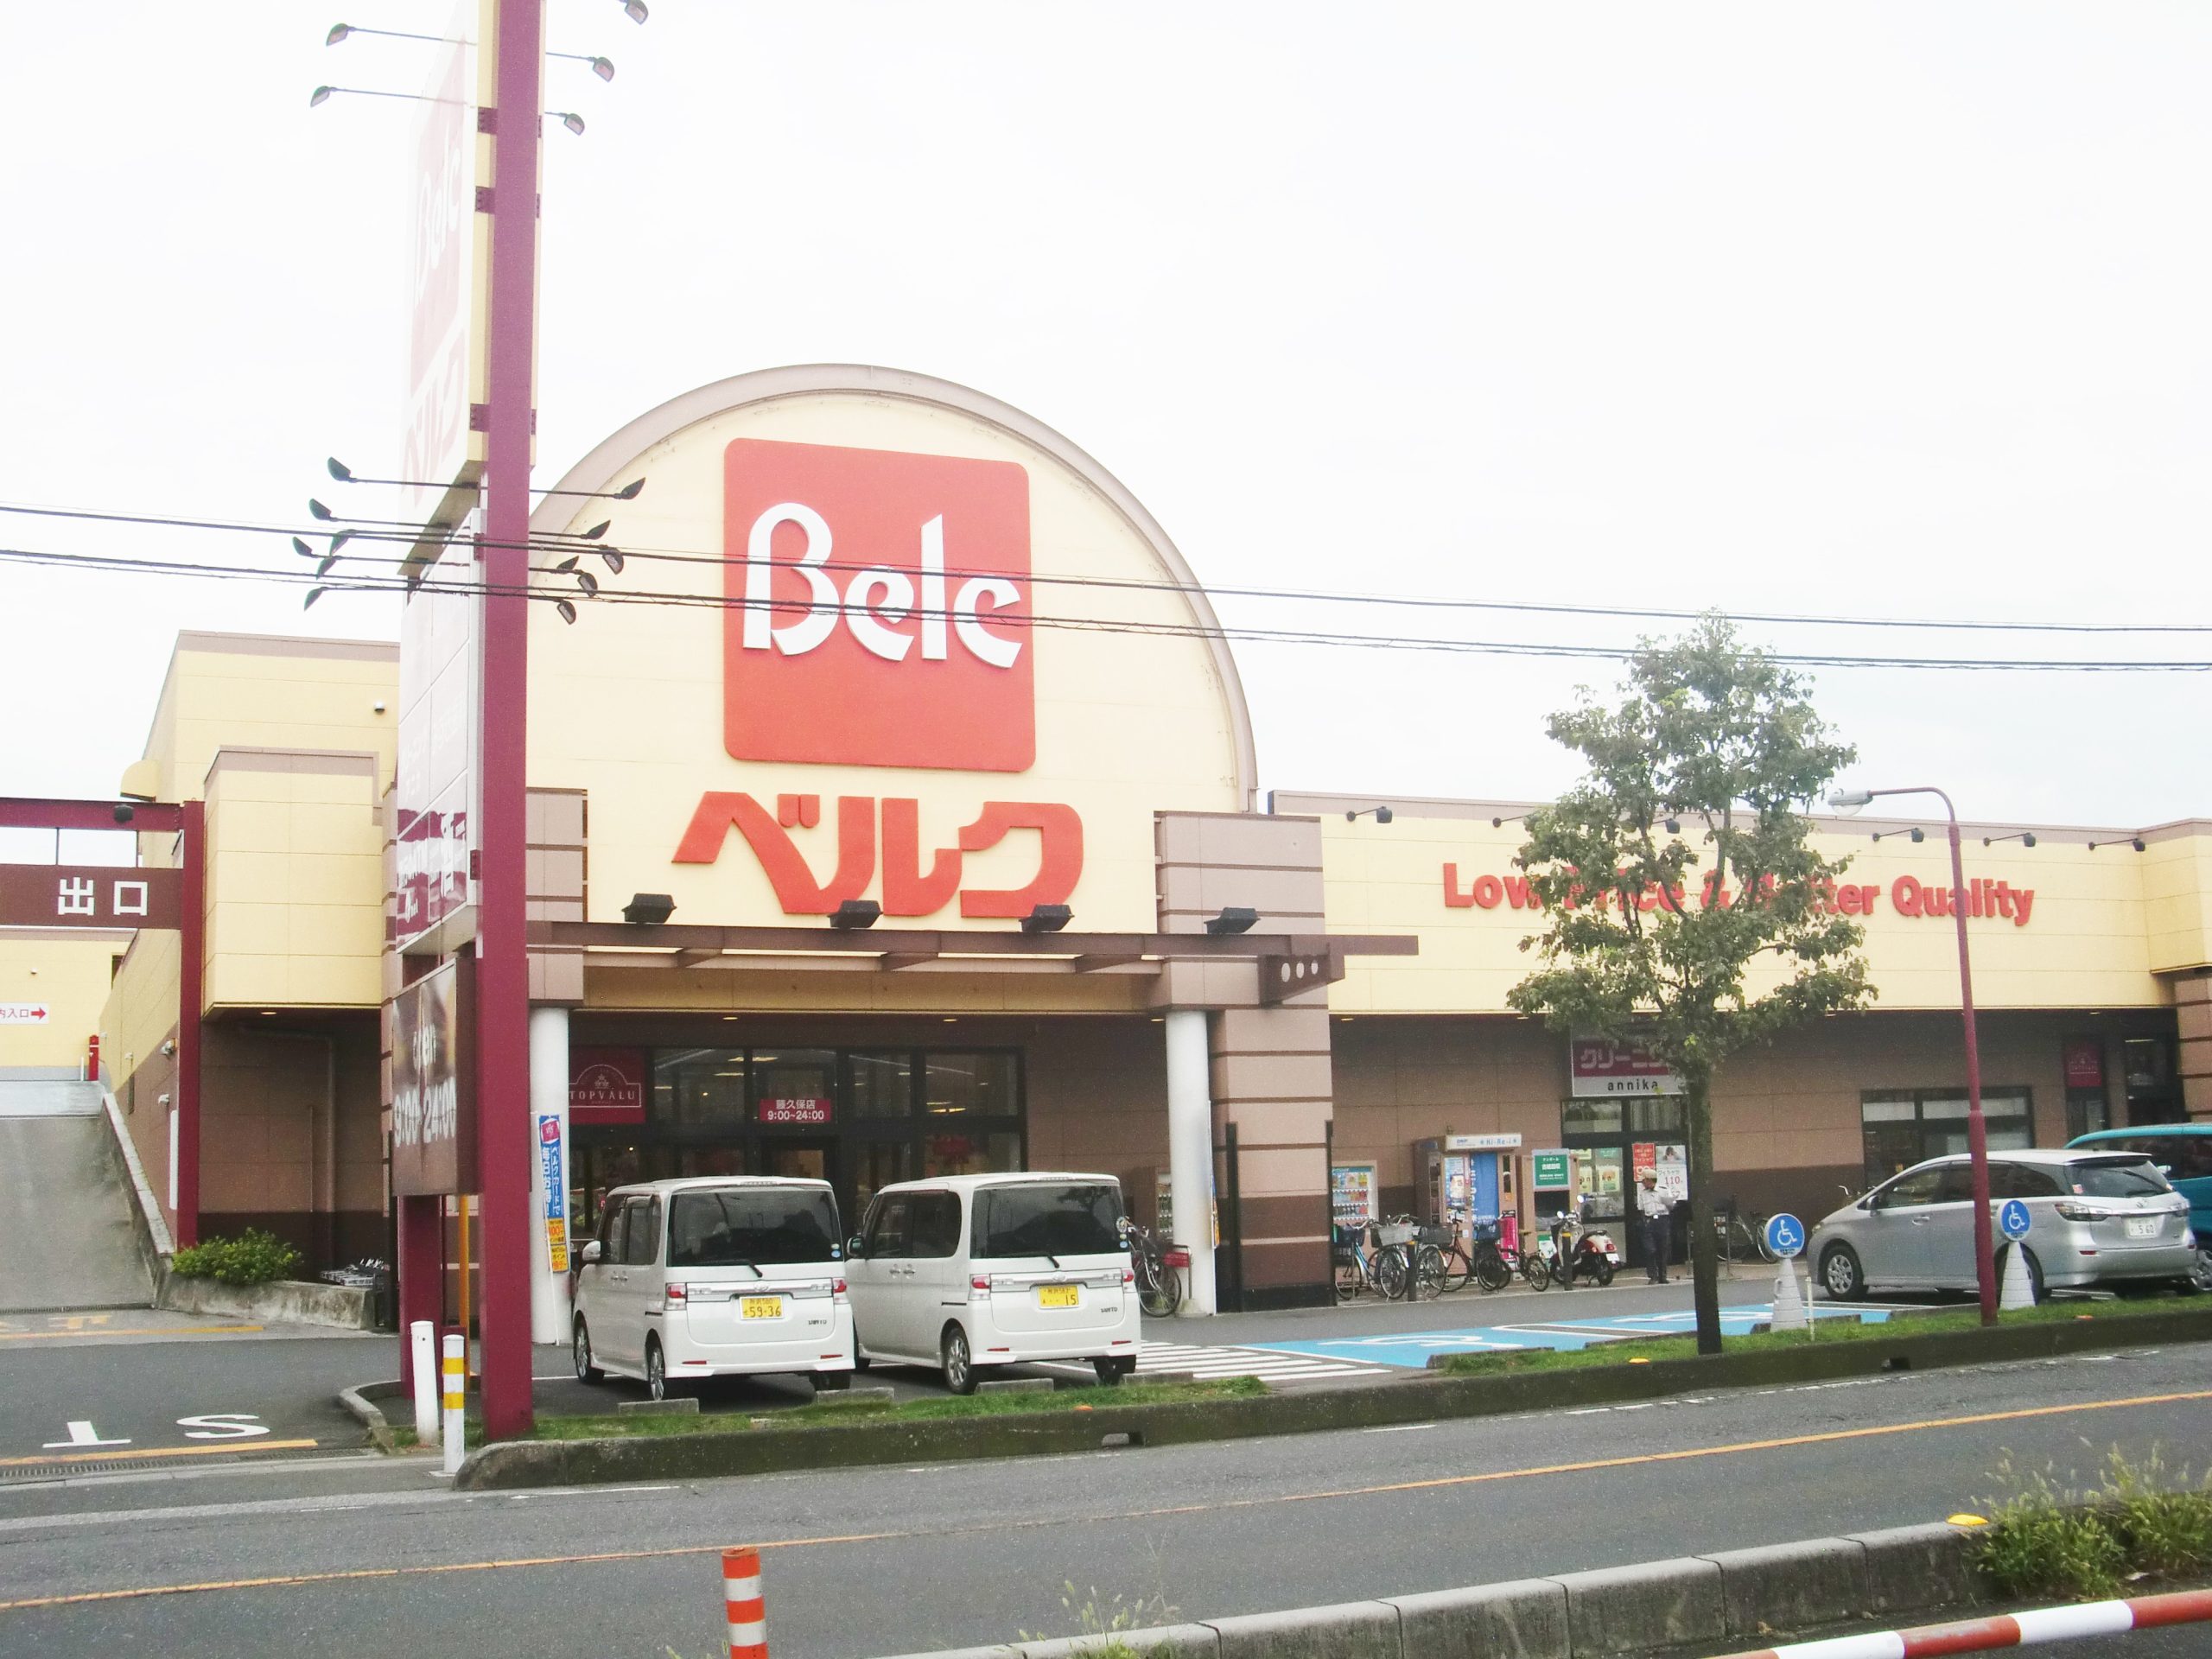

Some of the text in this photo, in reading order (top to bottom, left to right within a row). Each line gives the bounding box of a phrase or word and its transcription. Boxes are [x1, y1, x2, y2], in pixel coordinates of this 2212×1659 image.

[743, 502, 1021, 669] Belc
[671, 791, 1084, 918] ベルク
[57, 876, 149, 917] 出口
[1443, 862, 1543, 910] Low
[1891, 875, 2035, 927] Quality
[1607, 1078, 1658, 1091] annika
